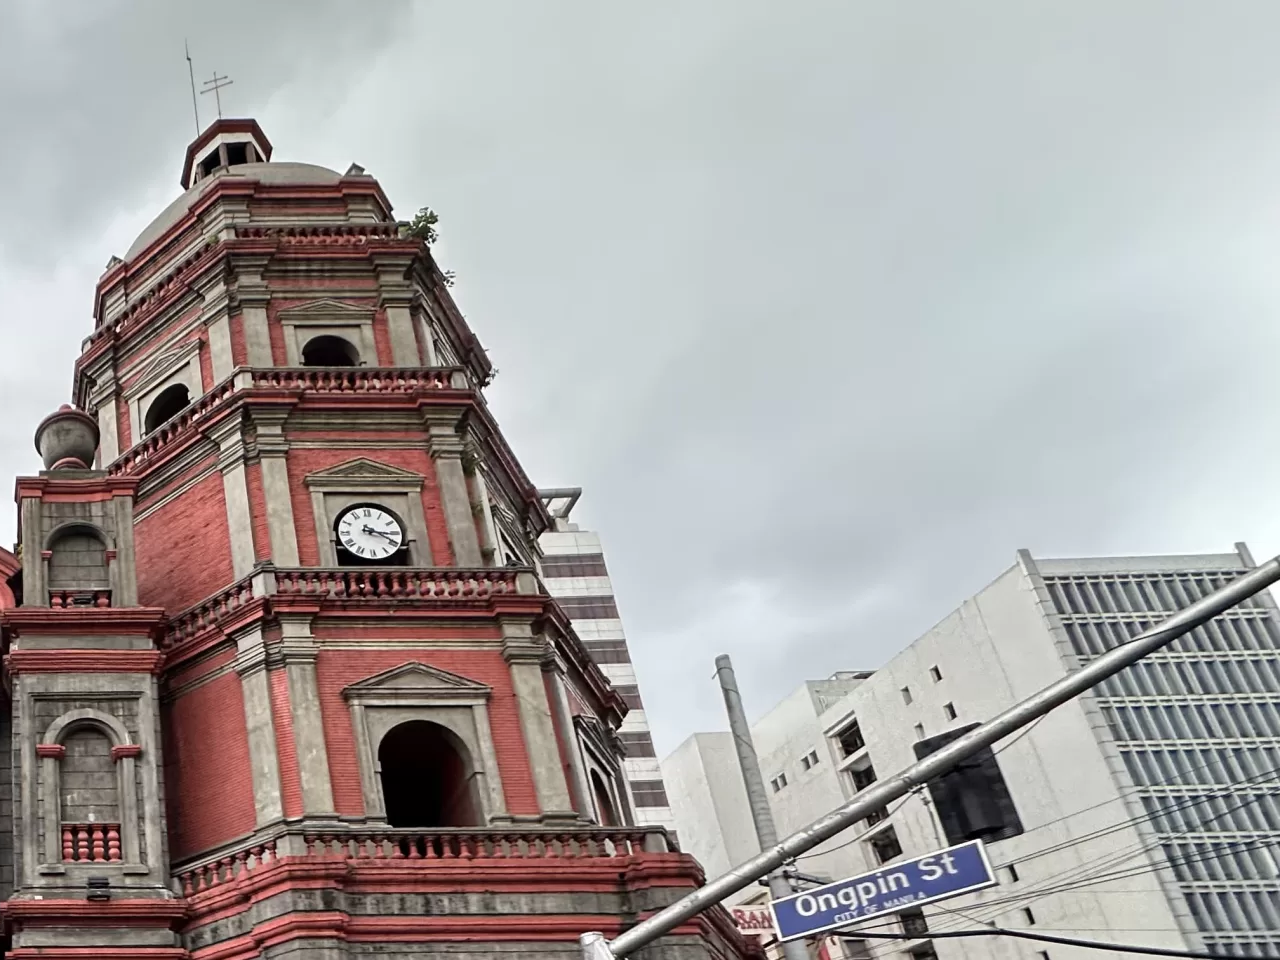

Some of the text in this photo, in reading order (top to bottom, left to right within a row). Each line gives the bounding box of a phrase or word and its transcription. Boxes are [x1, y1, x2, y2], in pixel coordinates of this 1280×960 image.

[795, 853, 959, 916] Ongpin St
[834, 910, 859, 923] CITY
[864, 904, 878, 915] OF
